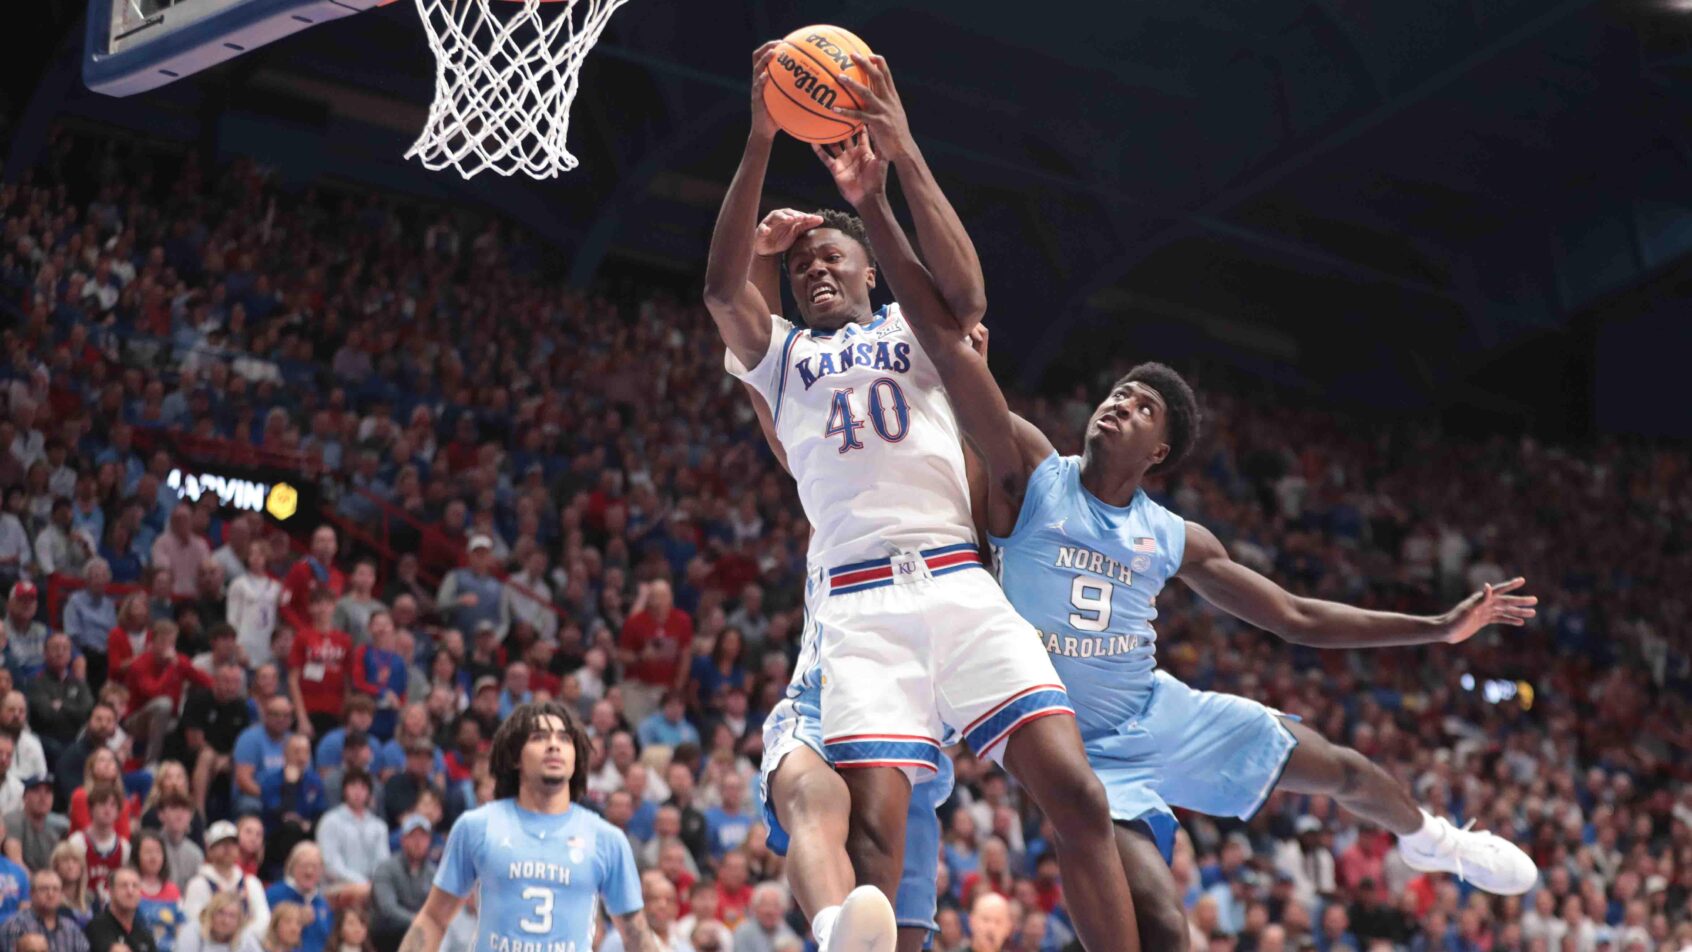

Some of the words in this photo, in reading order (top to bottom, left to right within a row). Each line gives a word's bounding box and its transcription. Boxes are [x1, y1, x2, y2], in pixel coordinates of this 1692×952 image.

[806, 34, 855, 71] NCAA
[776, 51, 837, 110] Wilson
[795, 341, 911, 391] KANSAS
[825, 376, 911, 454] 40
[897, 560, 917, 575] KU
[1055, 546, 1133, 587] NORTH
[1069, 574, 1114, 632] 9
[1036, 629, 1138, 658] AROLINA
[509, 860, 571, 886] NORTH
[519, 885, 555, 934] 3
